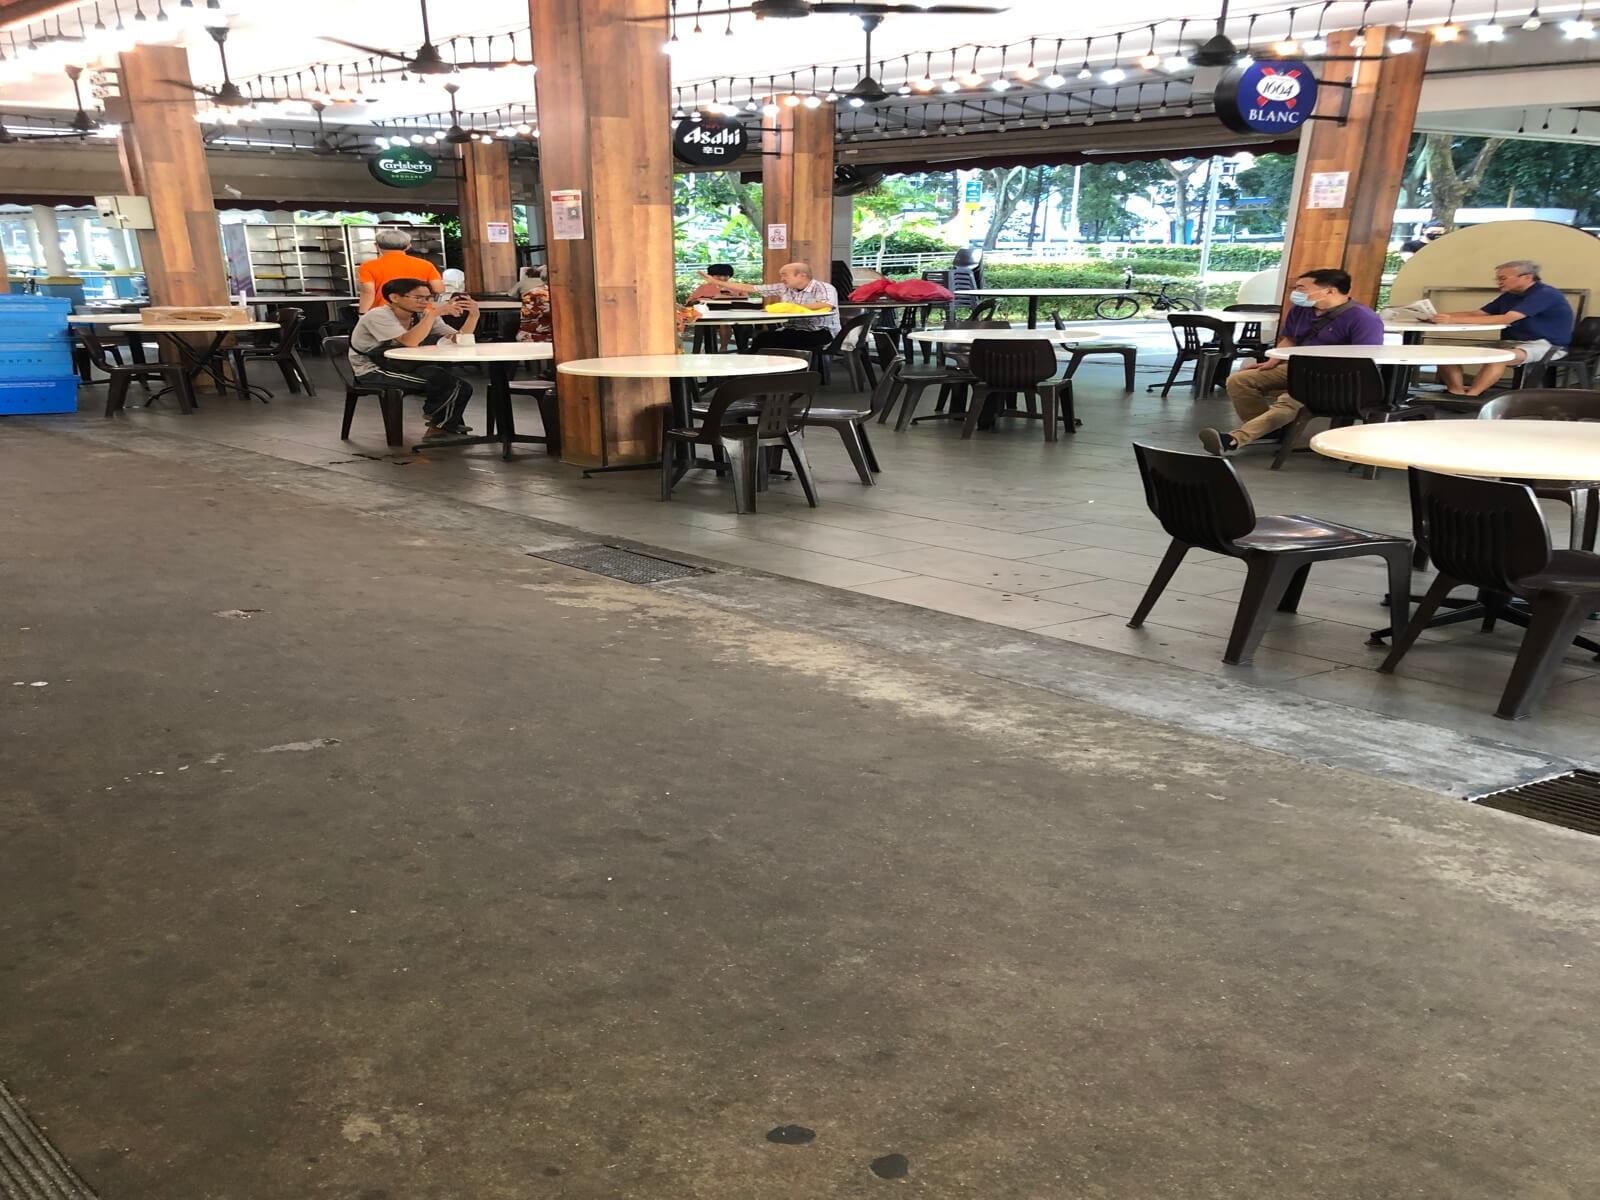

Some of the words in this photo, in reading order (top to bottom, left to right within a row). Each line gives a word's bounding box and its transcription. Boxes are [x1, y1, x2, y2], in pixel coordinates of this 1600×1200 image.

[1262, 81, 1295, 97] 1664
[1248, 108, 1300, 124] BLANC
[683, 126, 741, 146] Asahi
[379, 158, 433, 174] Carlsberg
